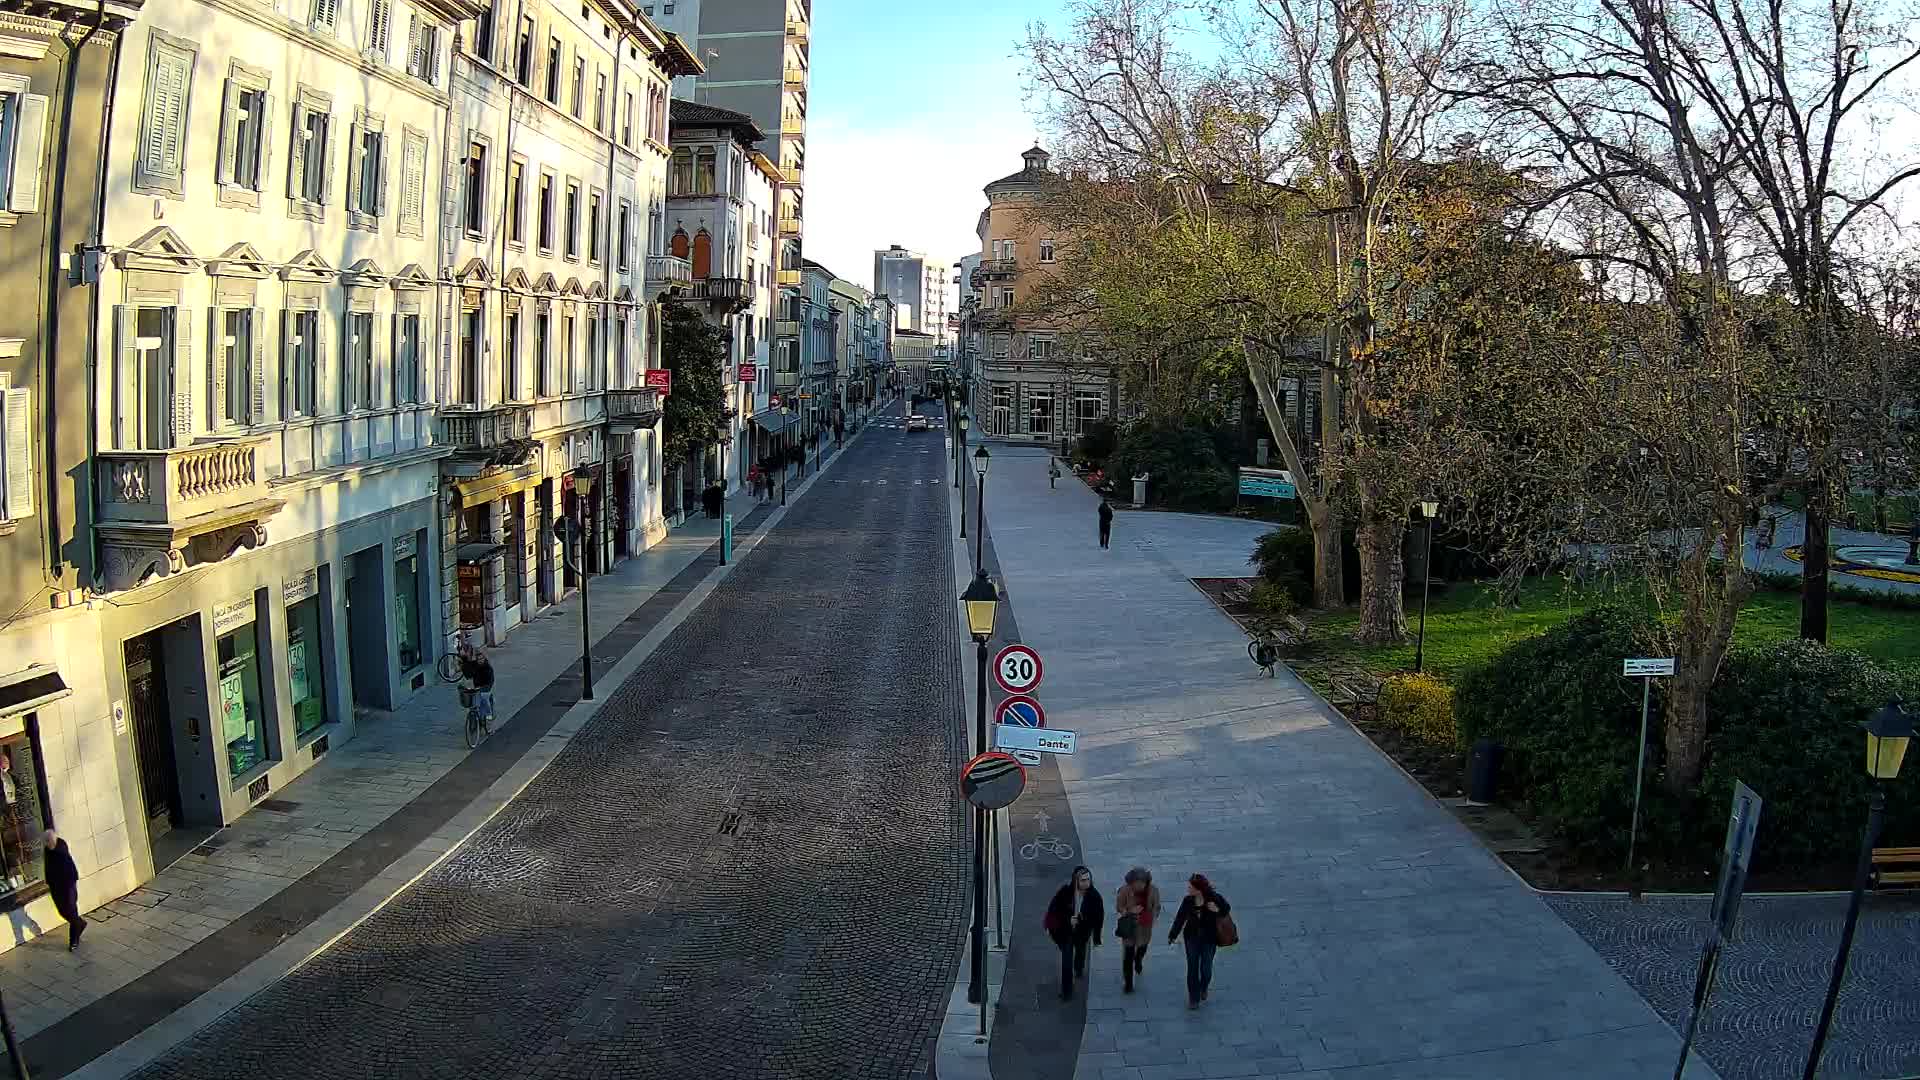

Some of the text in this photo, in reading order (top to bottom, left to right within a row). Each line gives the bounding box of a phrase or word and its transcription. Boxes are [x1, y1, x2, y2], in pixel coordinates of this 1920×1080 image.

[1006, 658, 1033, 680] 30
[220, 678, 241, 700] 130
[1038, 738, 1070, 750] Dante
